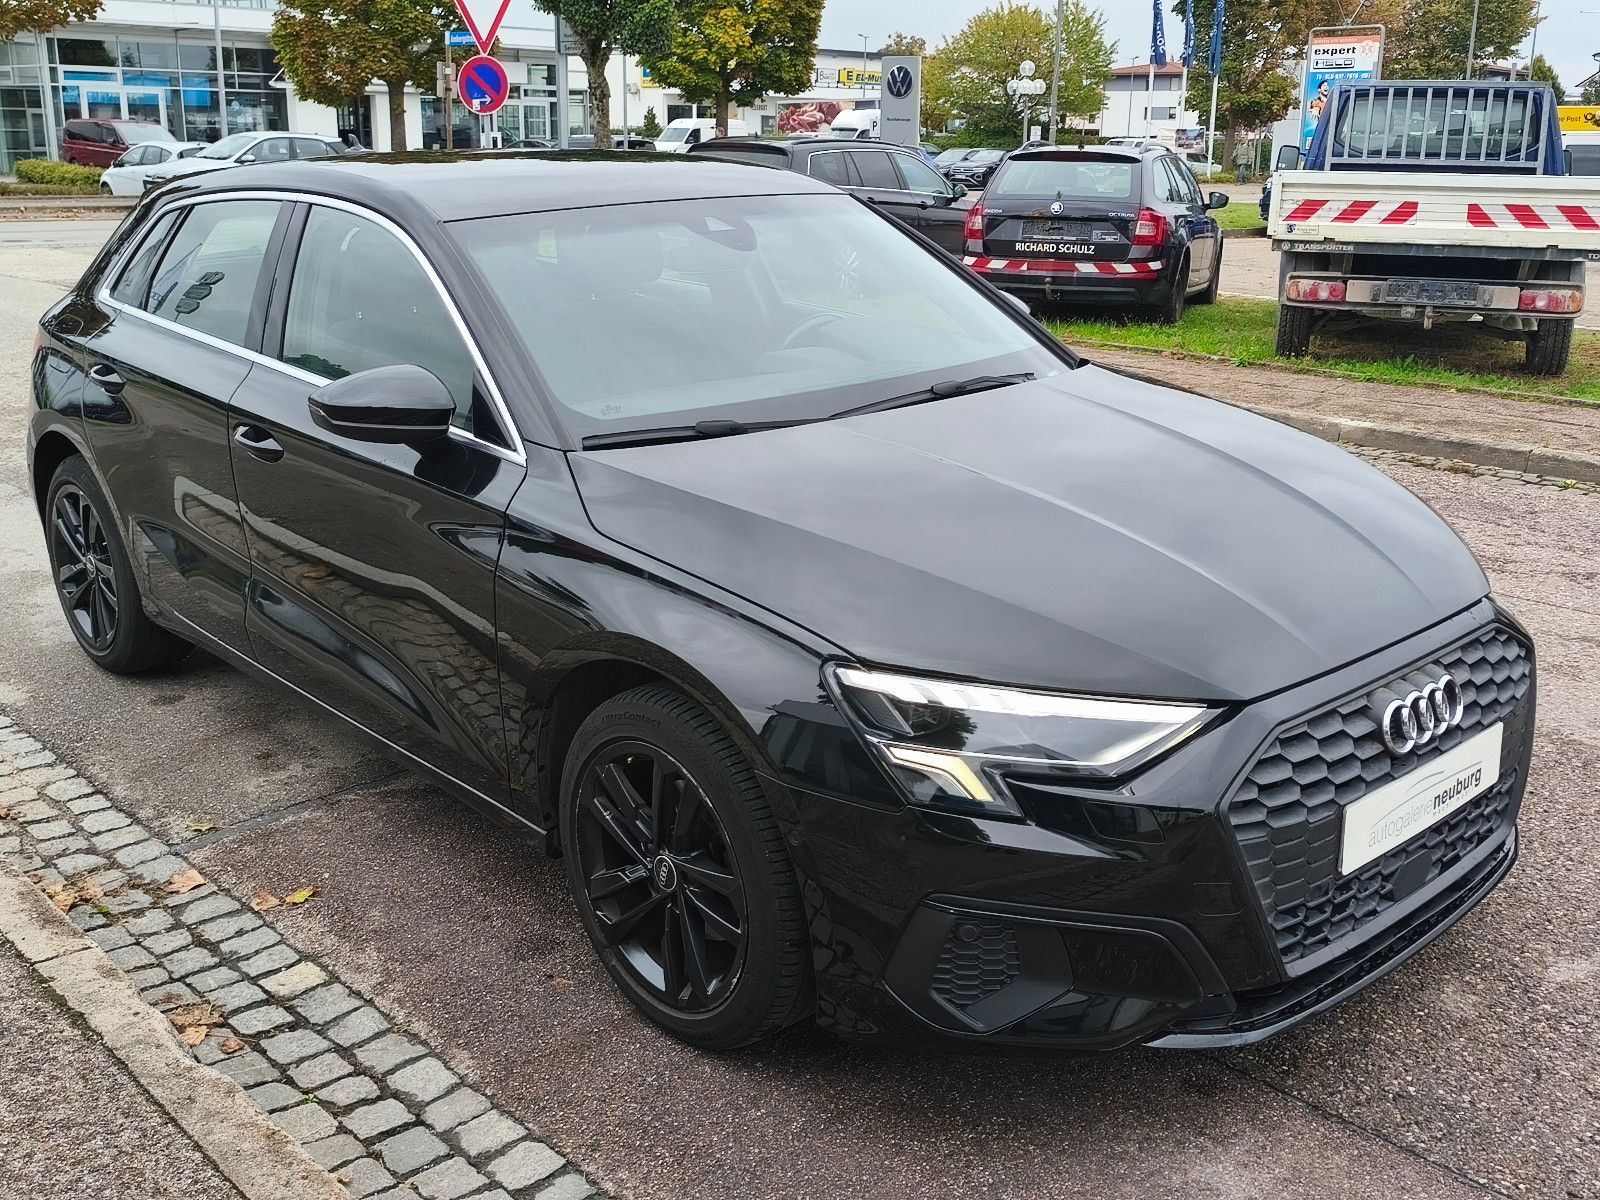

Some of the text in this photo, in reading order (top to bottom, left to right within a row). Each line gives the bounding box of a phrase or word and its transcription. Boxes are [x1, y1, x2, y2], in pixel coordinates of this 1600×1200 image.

[1314, 46, 1356, 56] expert
[872, 121, 877, 131] P
[1015, 242, 1095, 254] RICHARD SCHULZ
[1294, 243, 1354, 251] TRANSPORTER
